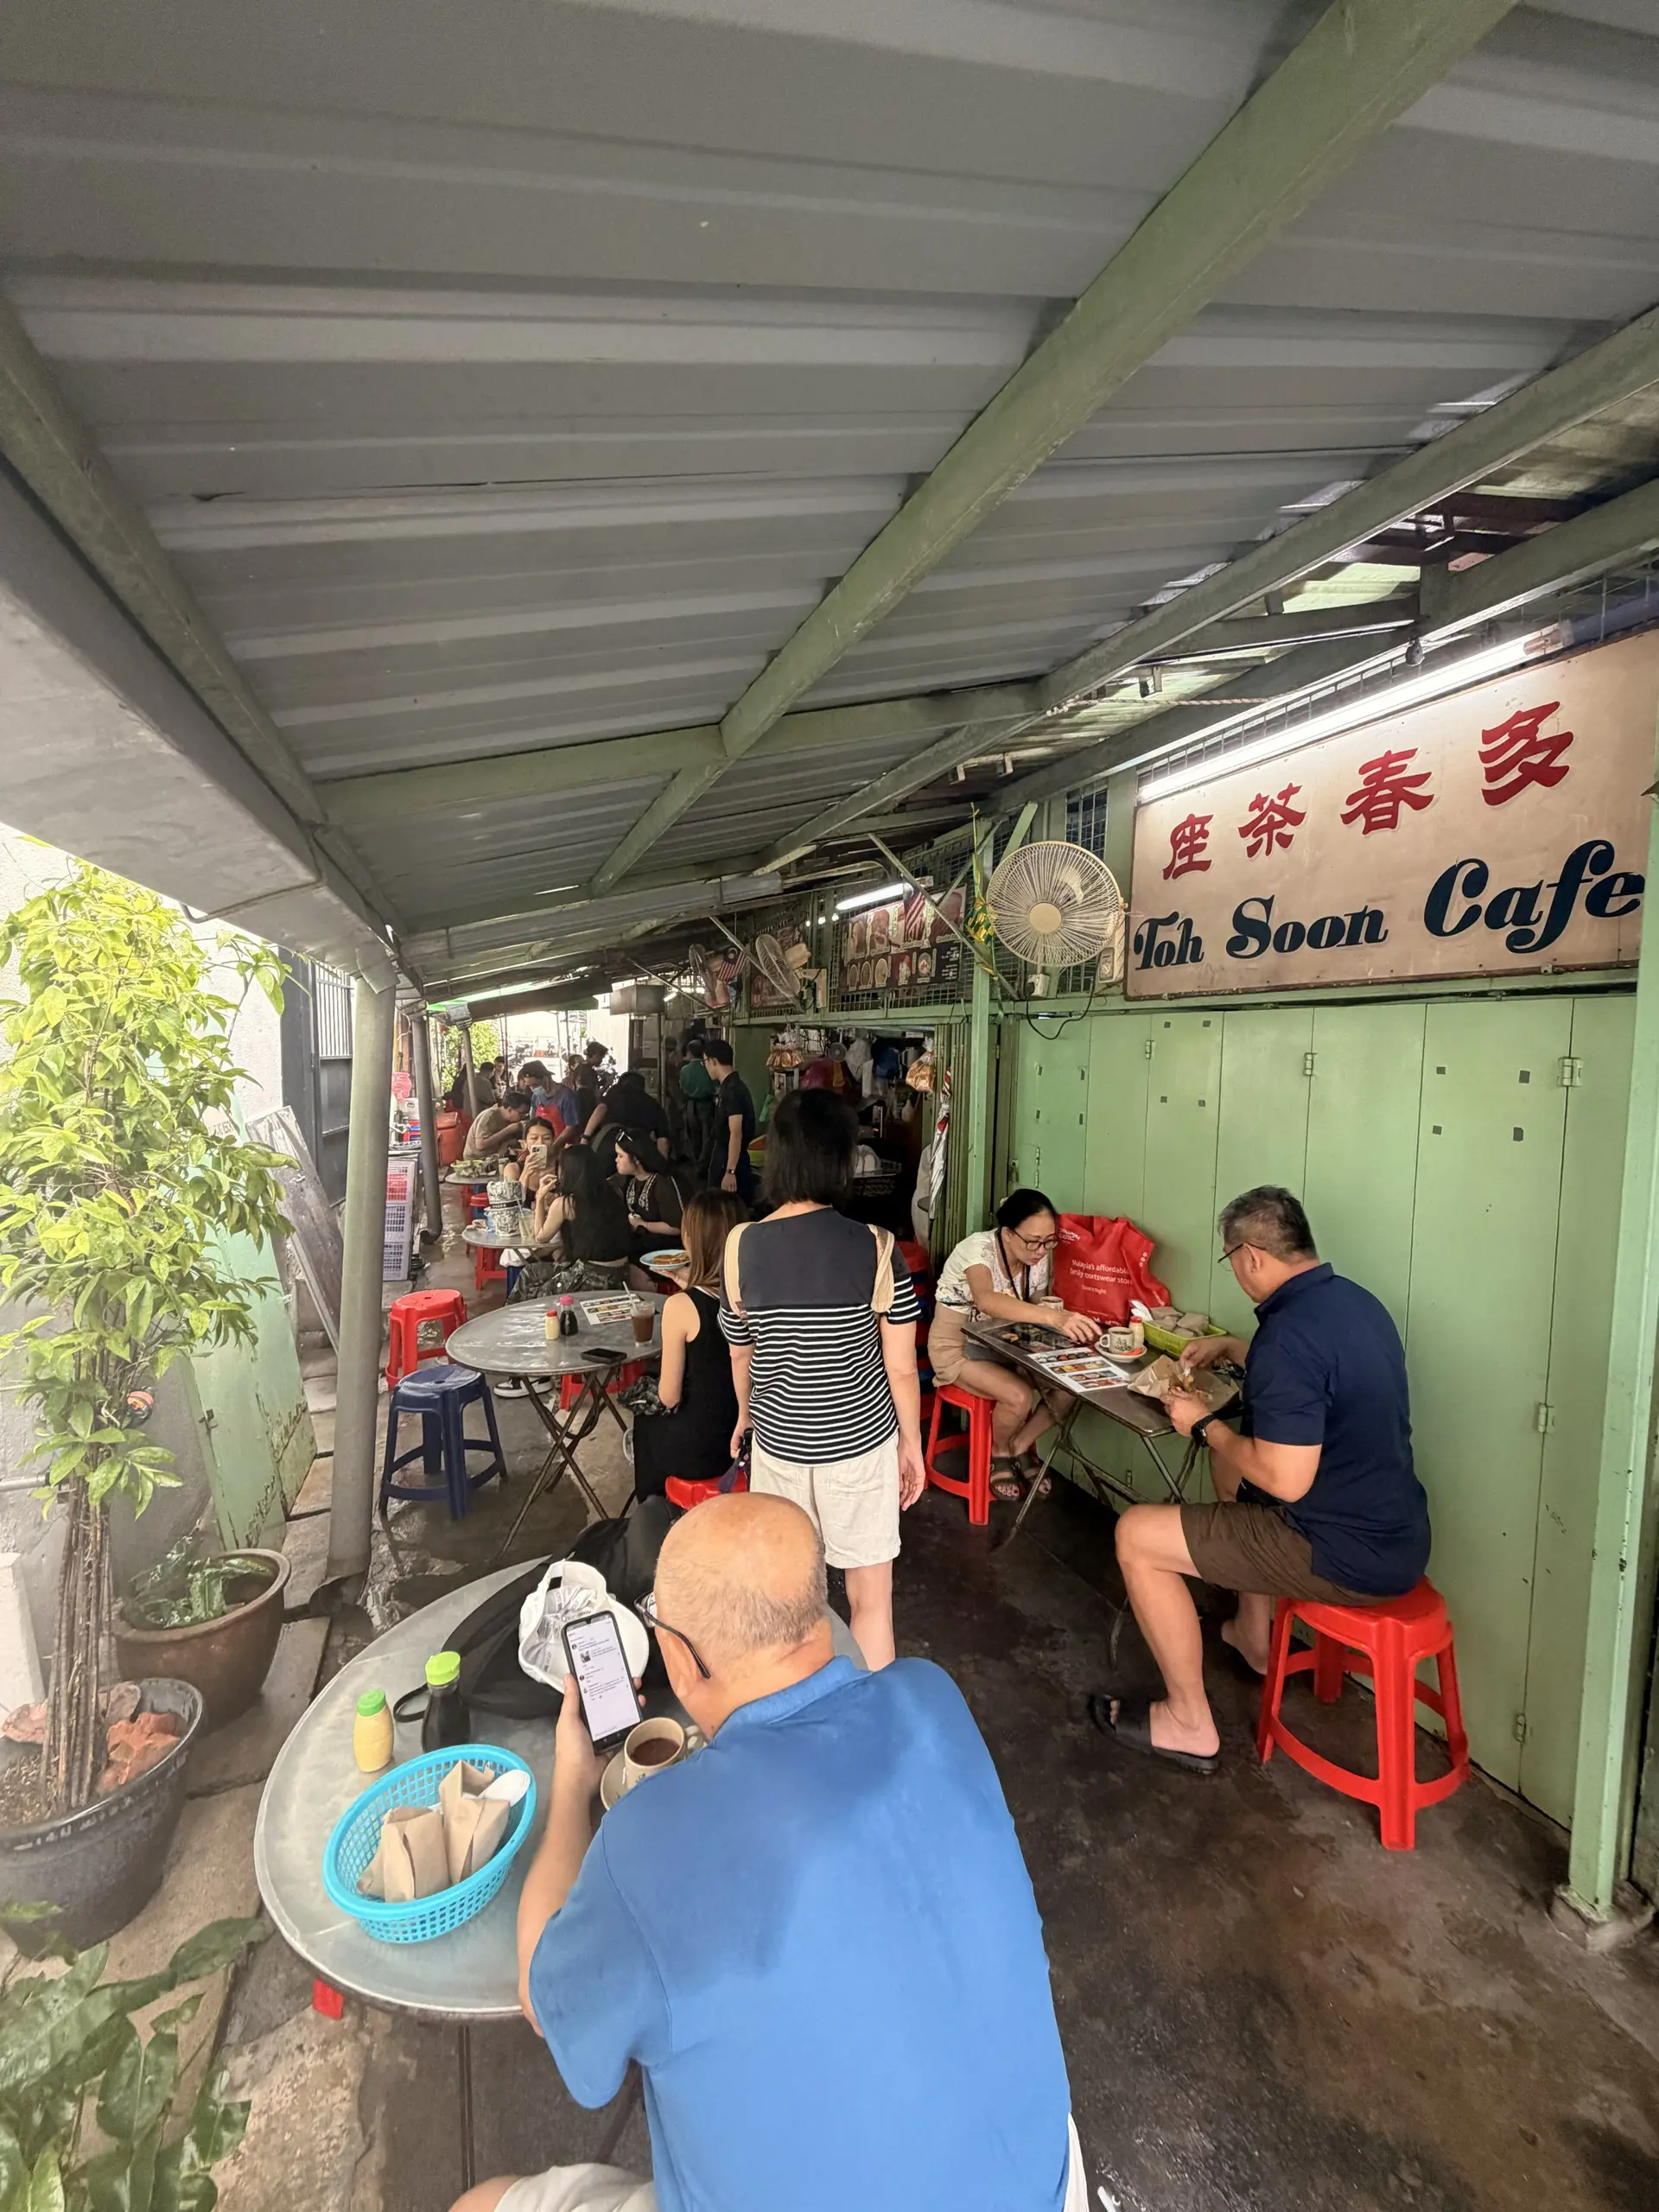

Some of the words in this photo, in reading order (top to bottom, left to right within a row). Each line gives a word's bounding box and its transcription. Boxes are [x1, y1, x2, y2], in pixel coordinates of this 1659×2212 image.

[1133, 911, 1204, 971] Toh
[1225, 895, 1389, 959] Soon
[1423, 839, 1646, 954] Cafe
[1084, 1272, 1116, 1283] portswear
